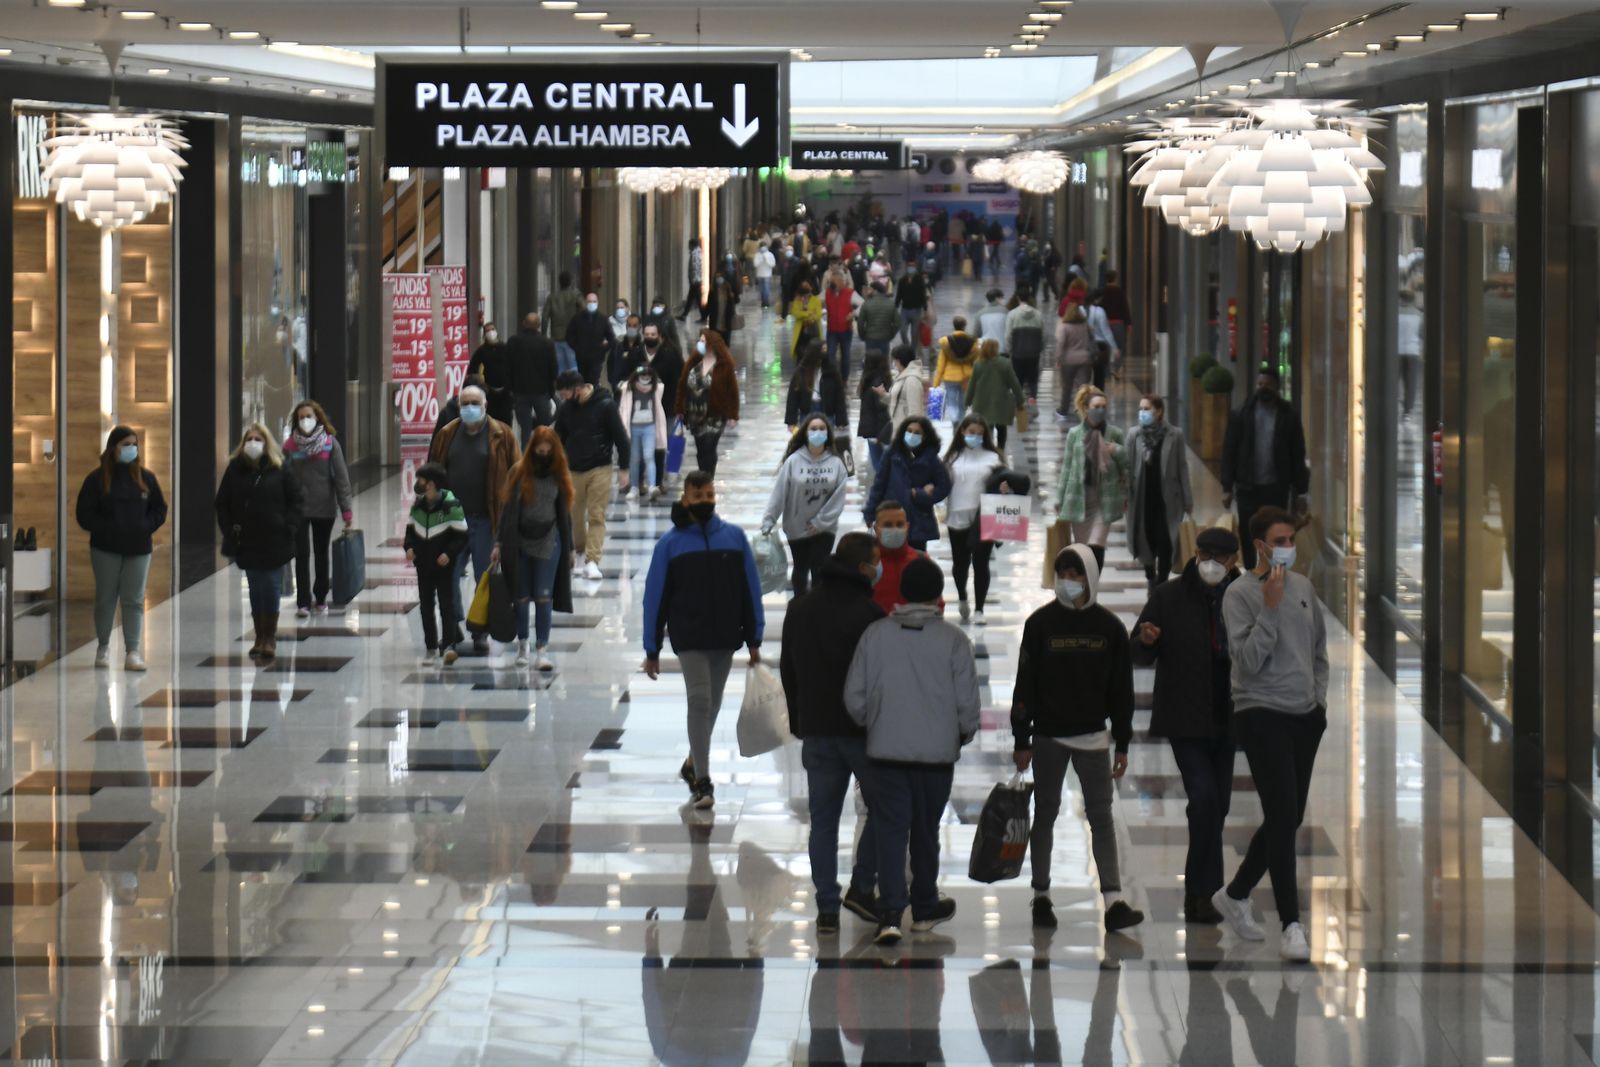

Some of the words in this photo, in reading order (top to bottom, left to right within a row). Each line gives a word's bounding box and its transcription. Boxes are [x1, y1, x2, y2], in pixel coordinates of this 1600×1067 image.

[417, 83, 533, 109] PLAZA
[546, 83, 713, 109] CENTRAL
[438, 125, 528, 146] PLAZA
[533, 125, 690, 146] ALHAMBRA
[804, 151, 838, 160] PLAZA
[840, 151, 888, 160] CENTRAL
[430, 268, 463, 285] NDAS
[384, 277, 428, 295] UNDAS
[996, 505, 1021, 515] #feel
